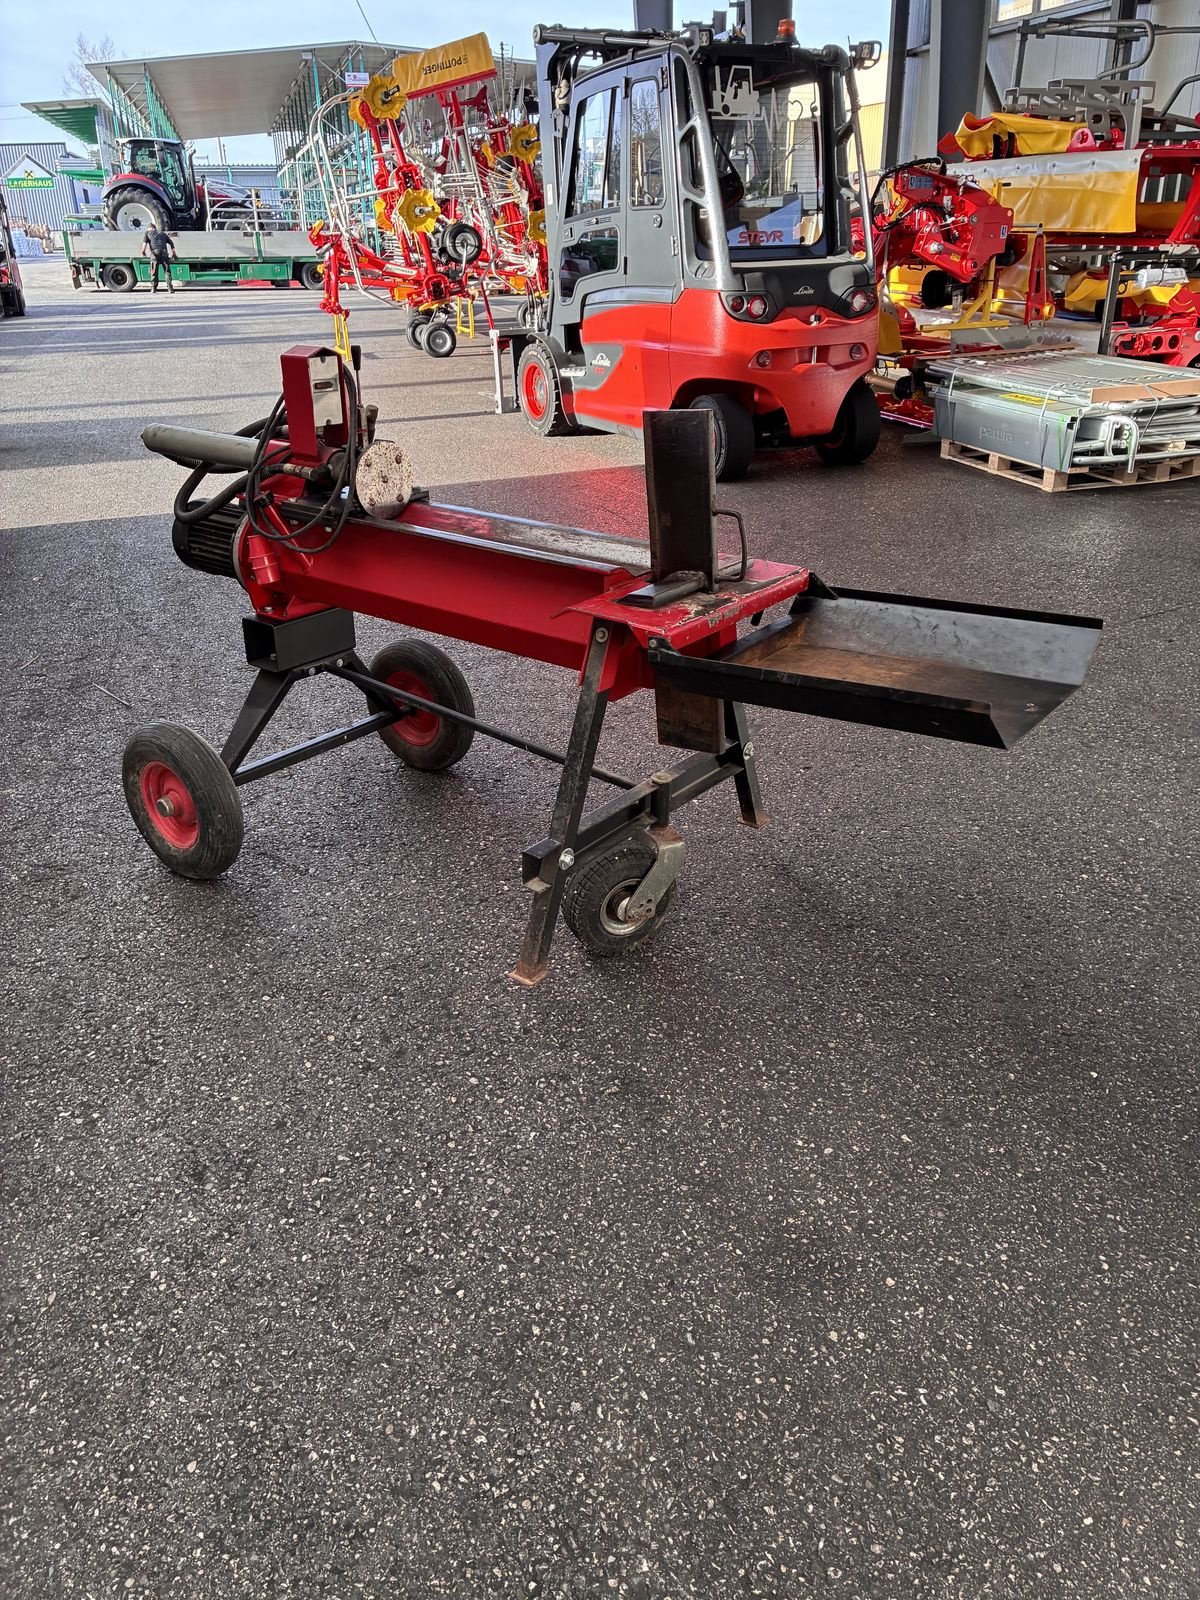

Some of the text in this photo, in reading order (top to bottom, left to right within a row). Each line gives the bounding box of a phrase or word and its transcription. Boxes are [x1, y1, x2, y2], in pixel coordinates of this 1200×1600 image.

[9, 180, 53, 188] LAGERHAUS
[737, 230, 784, 244] STEYR
[793, 285, 815, 296] Linde
